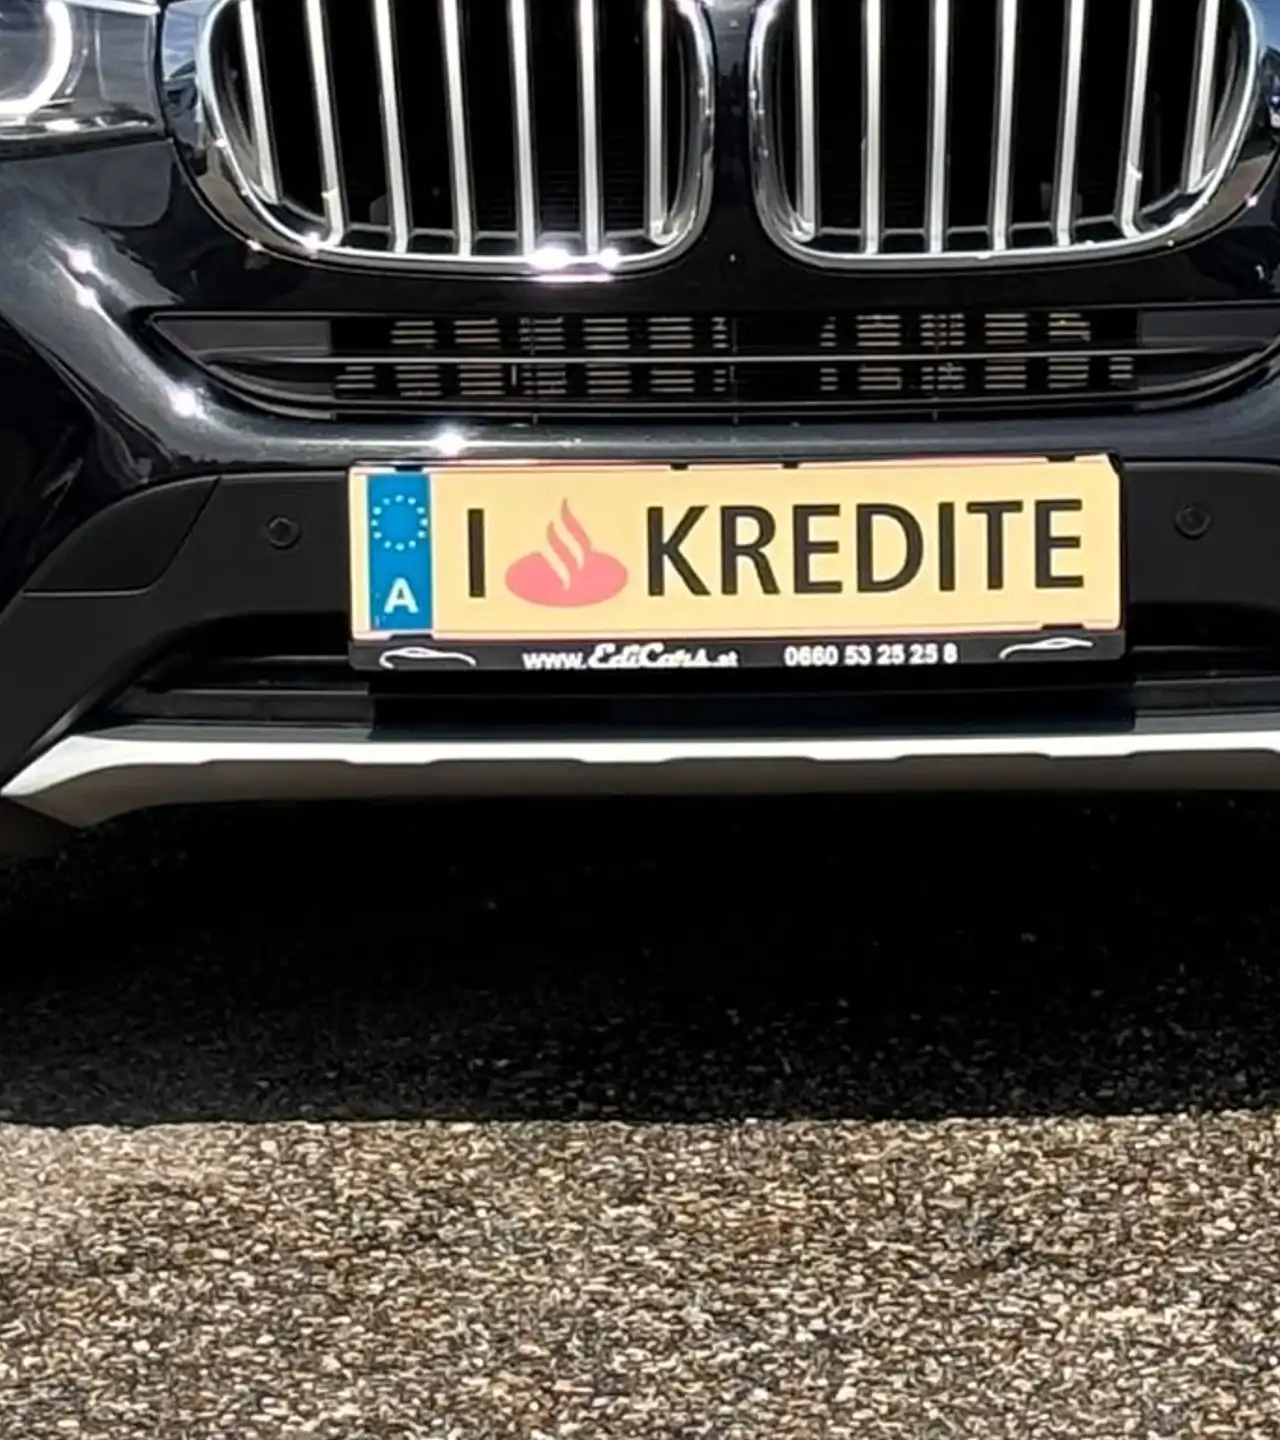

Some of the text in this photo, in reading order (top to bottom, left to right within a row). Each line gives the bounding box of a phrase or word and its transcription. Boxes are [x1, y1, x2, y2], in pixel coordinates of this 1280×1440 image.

[467, 498, 1085, 598] I KREDITE
[383, 577, 419, 614] A
[784, 645, 839, 667] 0660
[844, 644, 872, 666] 53
[876, 643, 905, 665] 25
[908, 643, 939, 665] 25
